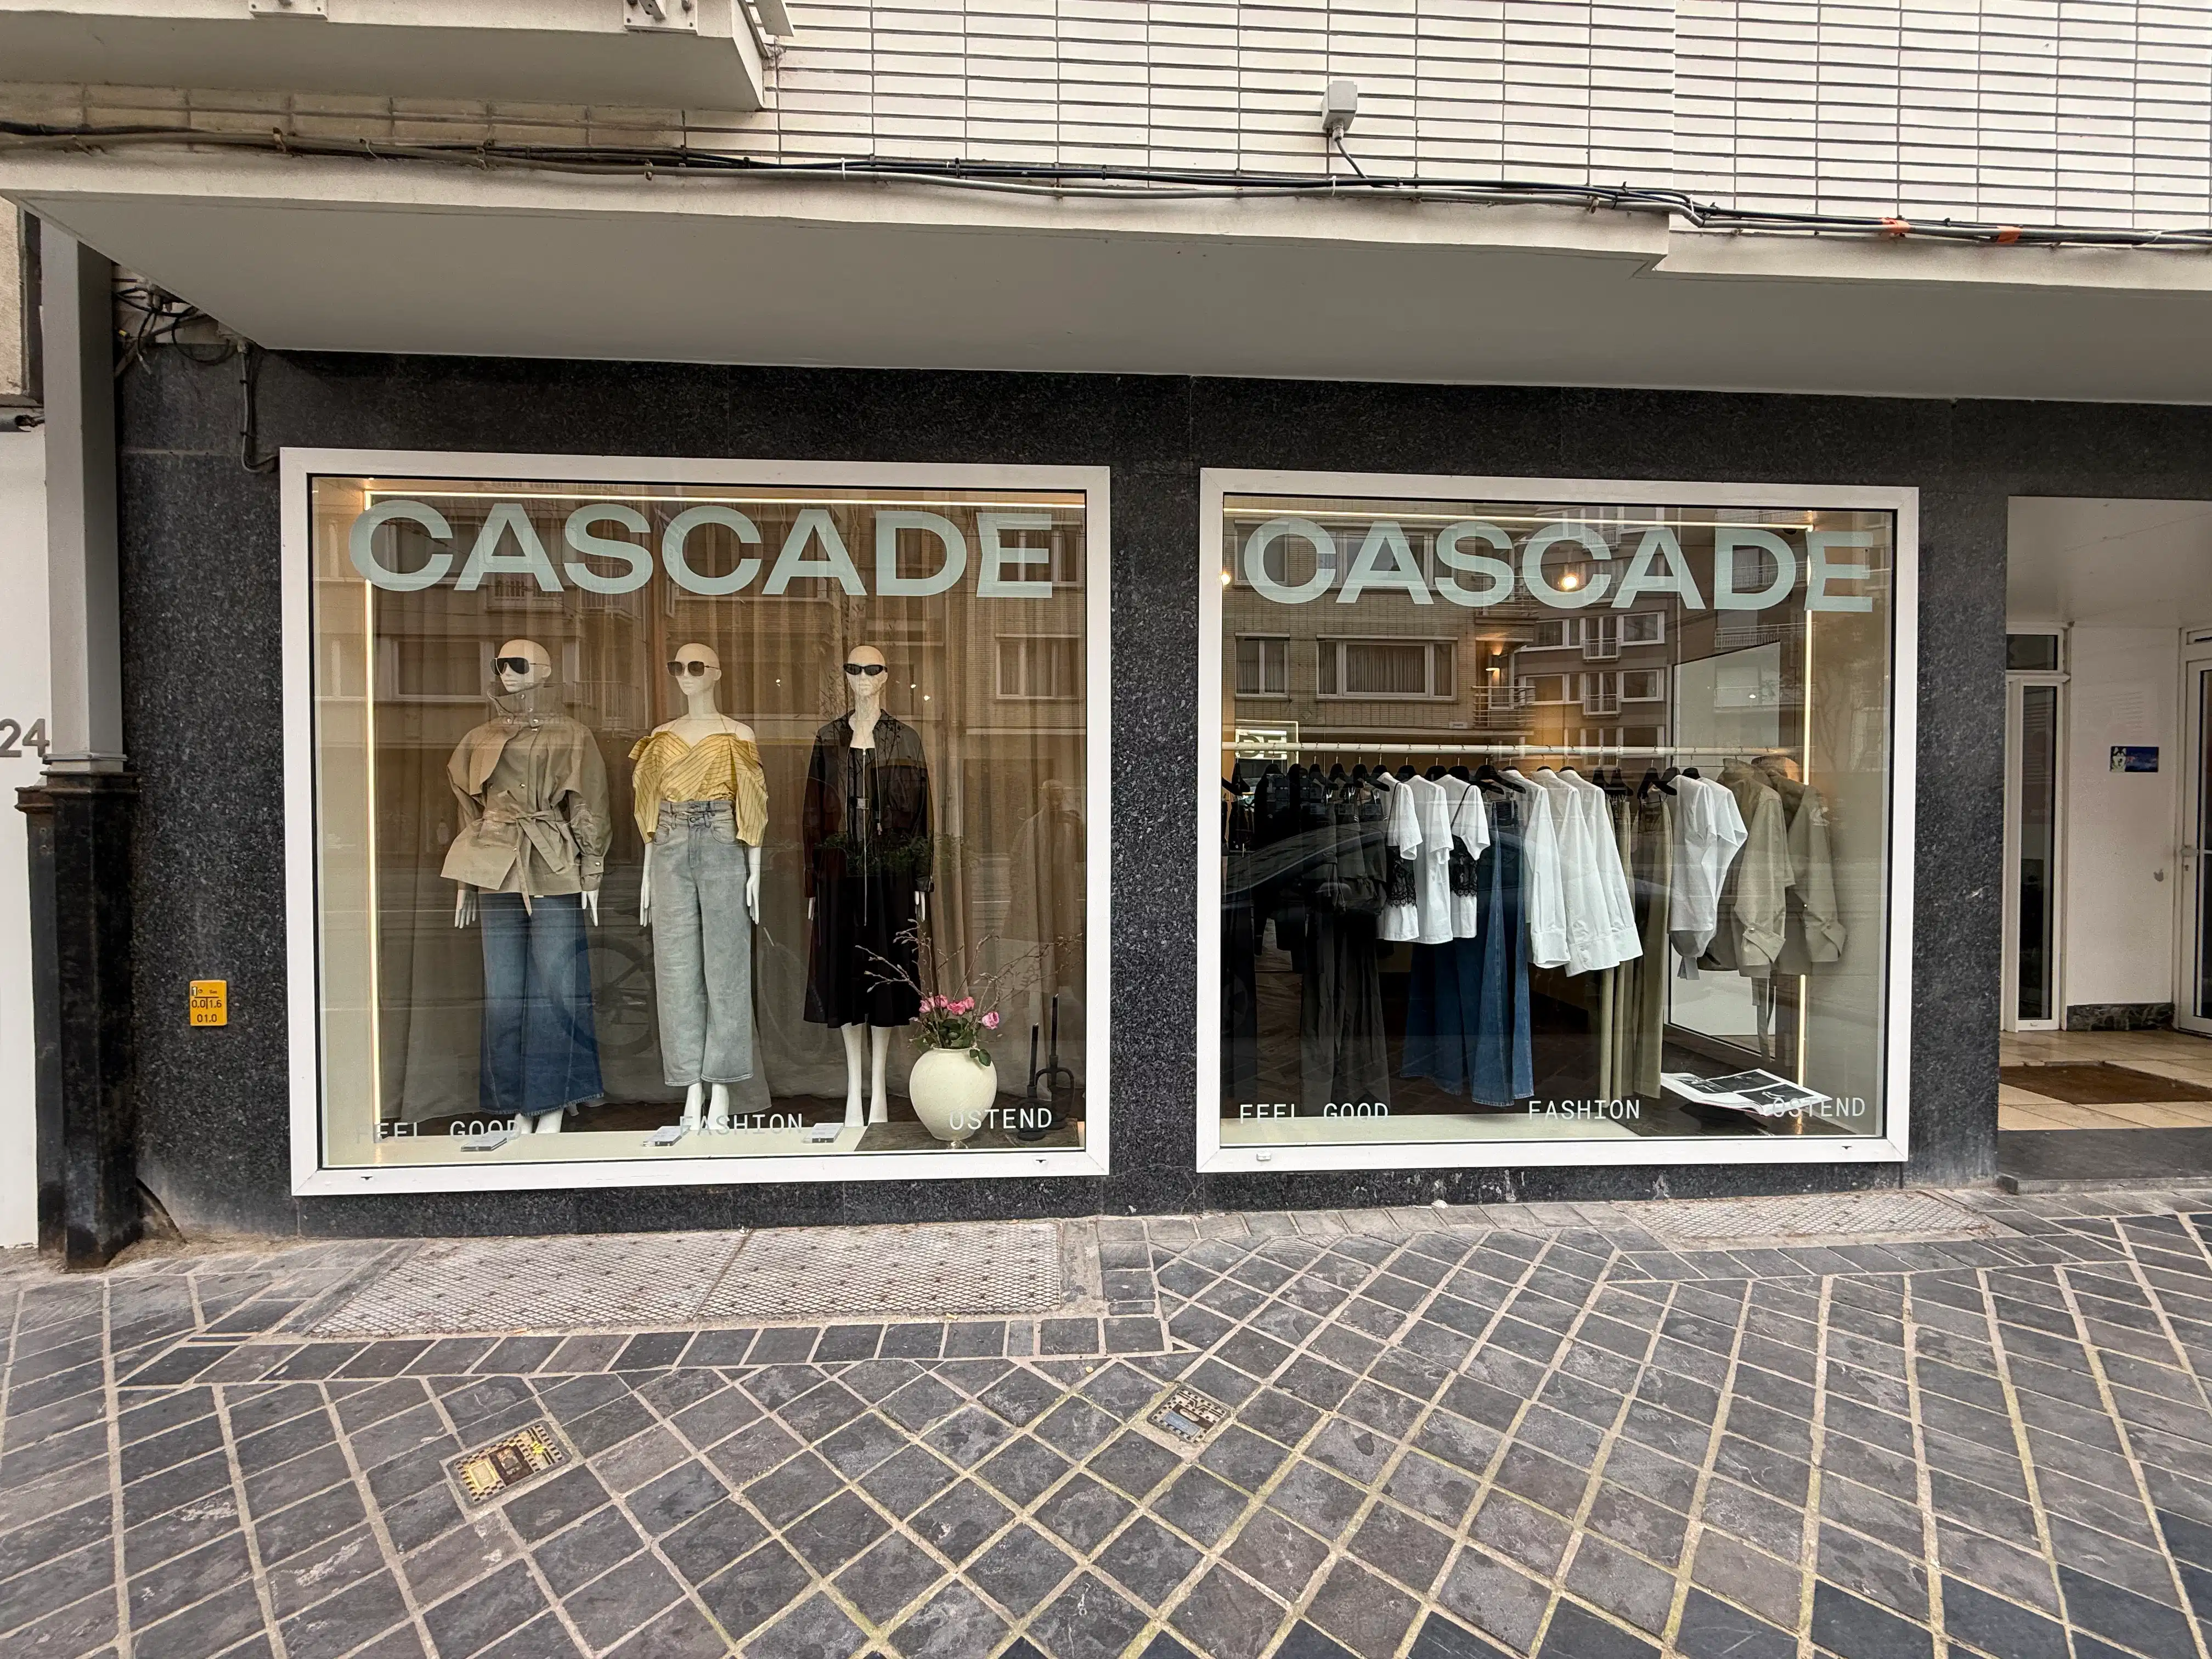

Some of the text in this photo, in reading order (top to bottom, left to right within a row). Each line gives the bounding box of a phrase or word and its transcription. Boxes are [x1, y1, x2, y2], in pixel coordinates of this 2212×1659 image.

[349, 500, 1052, 598] CASCADE
[1244, 517, 1873, 612] CASCADE
[0, 718, 50, 758] 24
[209, 1000, 222, 1008] 1.6
[680, 1113, 803, 1136] FASHION
[1324, 1103, 1389, 1122] GOOD
[1529, 1099, 1639, 1120] FASHION
[1773, 1097, 1865, 1118] OSTEND
